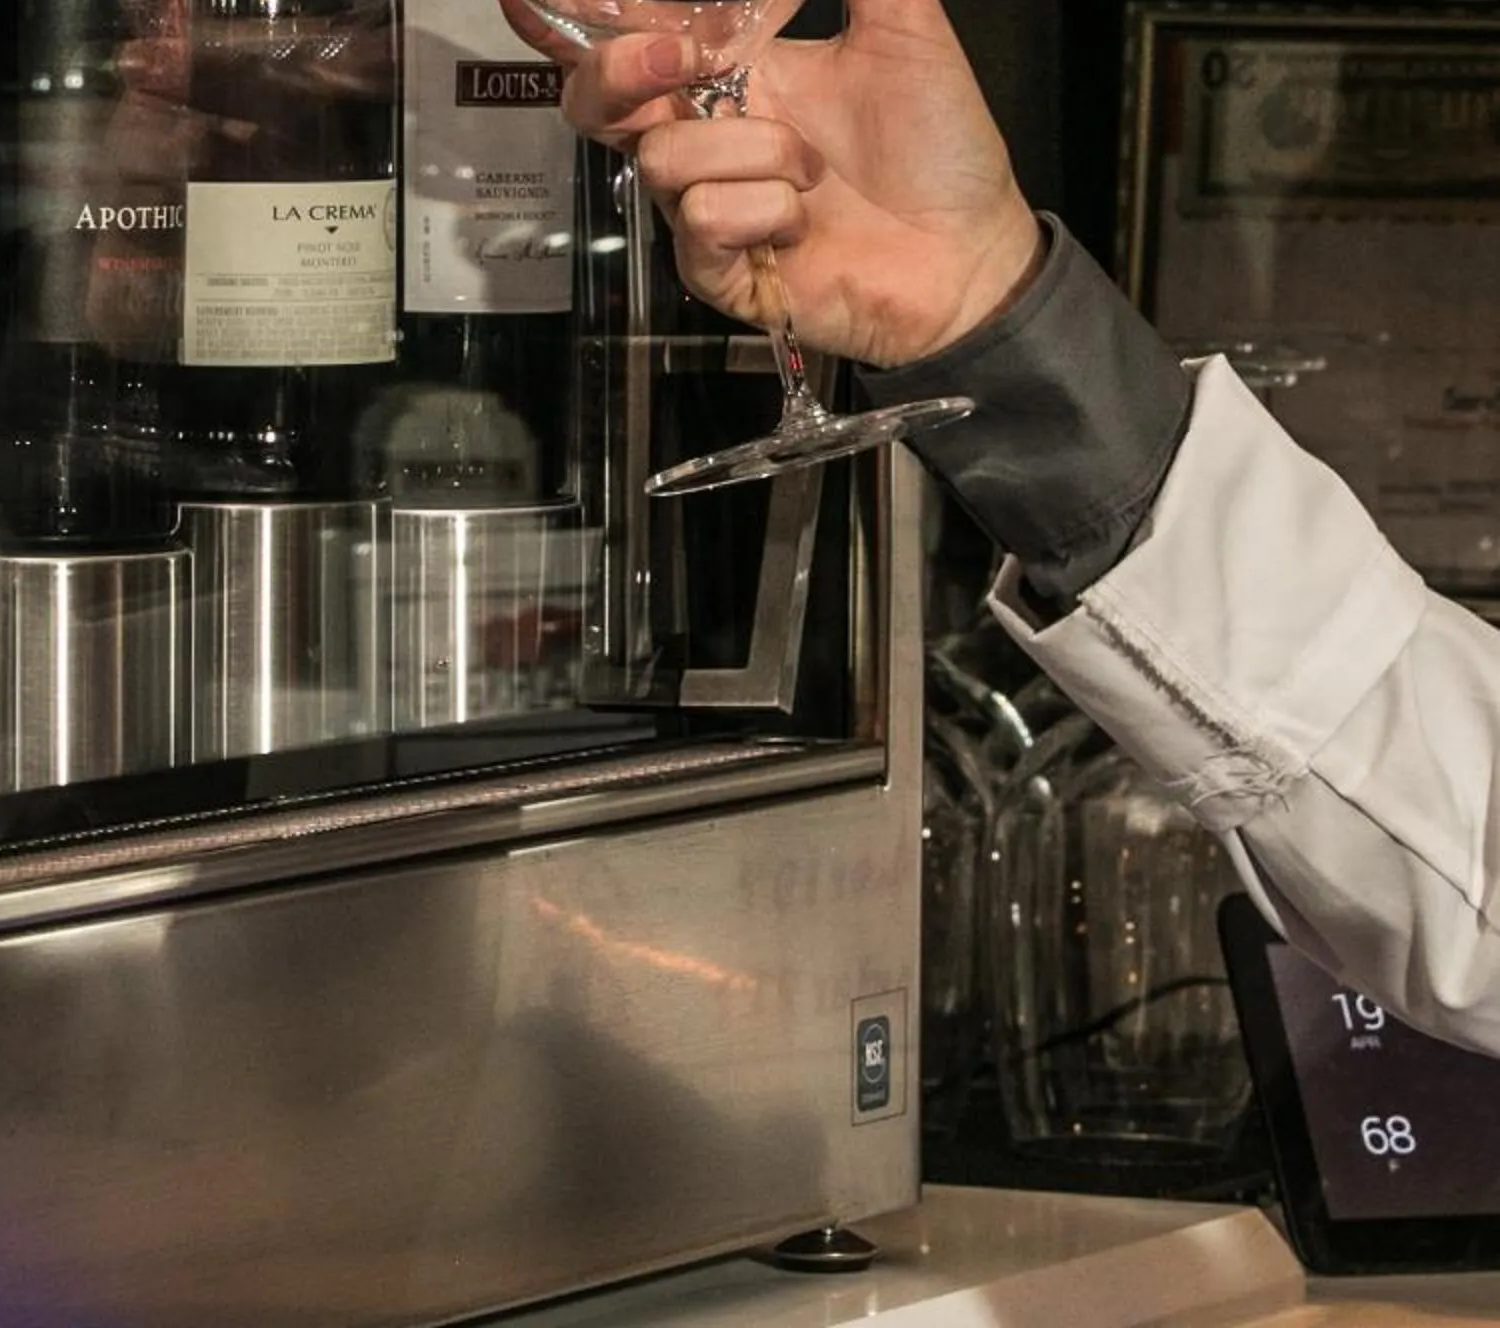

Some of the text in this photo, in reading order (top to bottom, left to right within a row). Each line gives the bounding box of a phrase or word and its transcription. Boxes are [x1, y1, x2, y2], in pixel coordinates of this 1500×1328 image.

[473, 68, 540, 100] LOUIS
[273, 203, 377, 221] LA CREMA
[1332, 994, 1385, 1030] 19
[1360, 1115, 1417, 1155] 68
